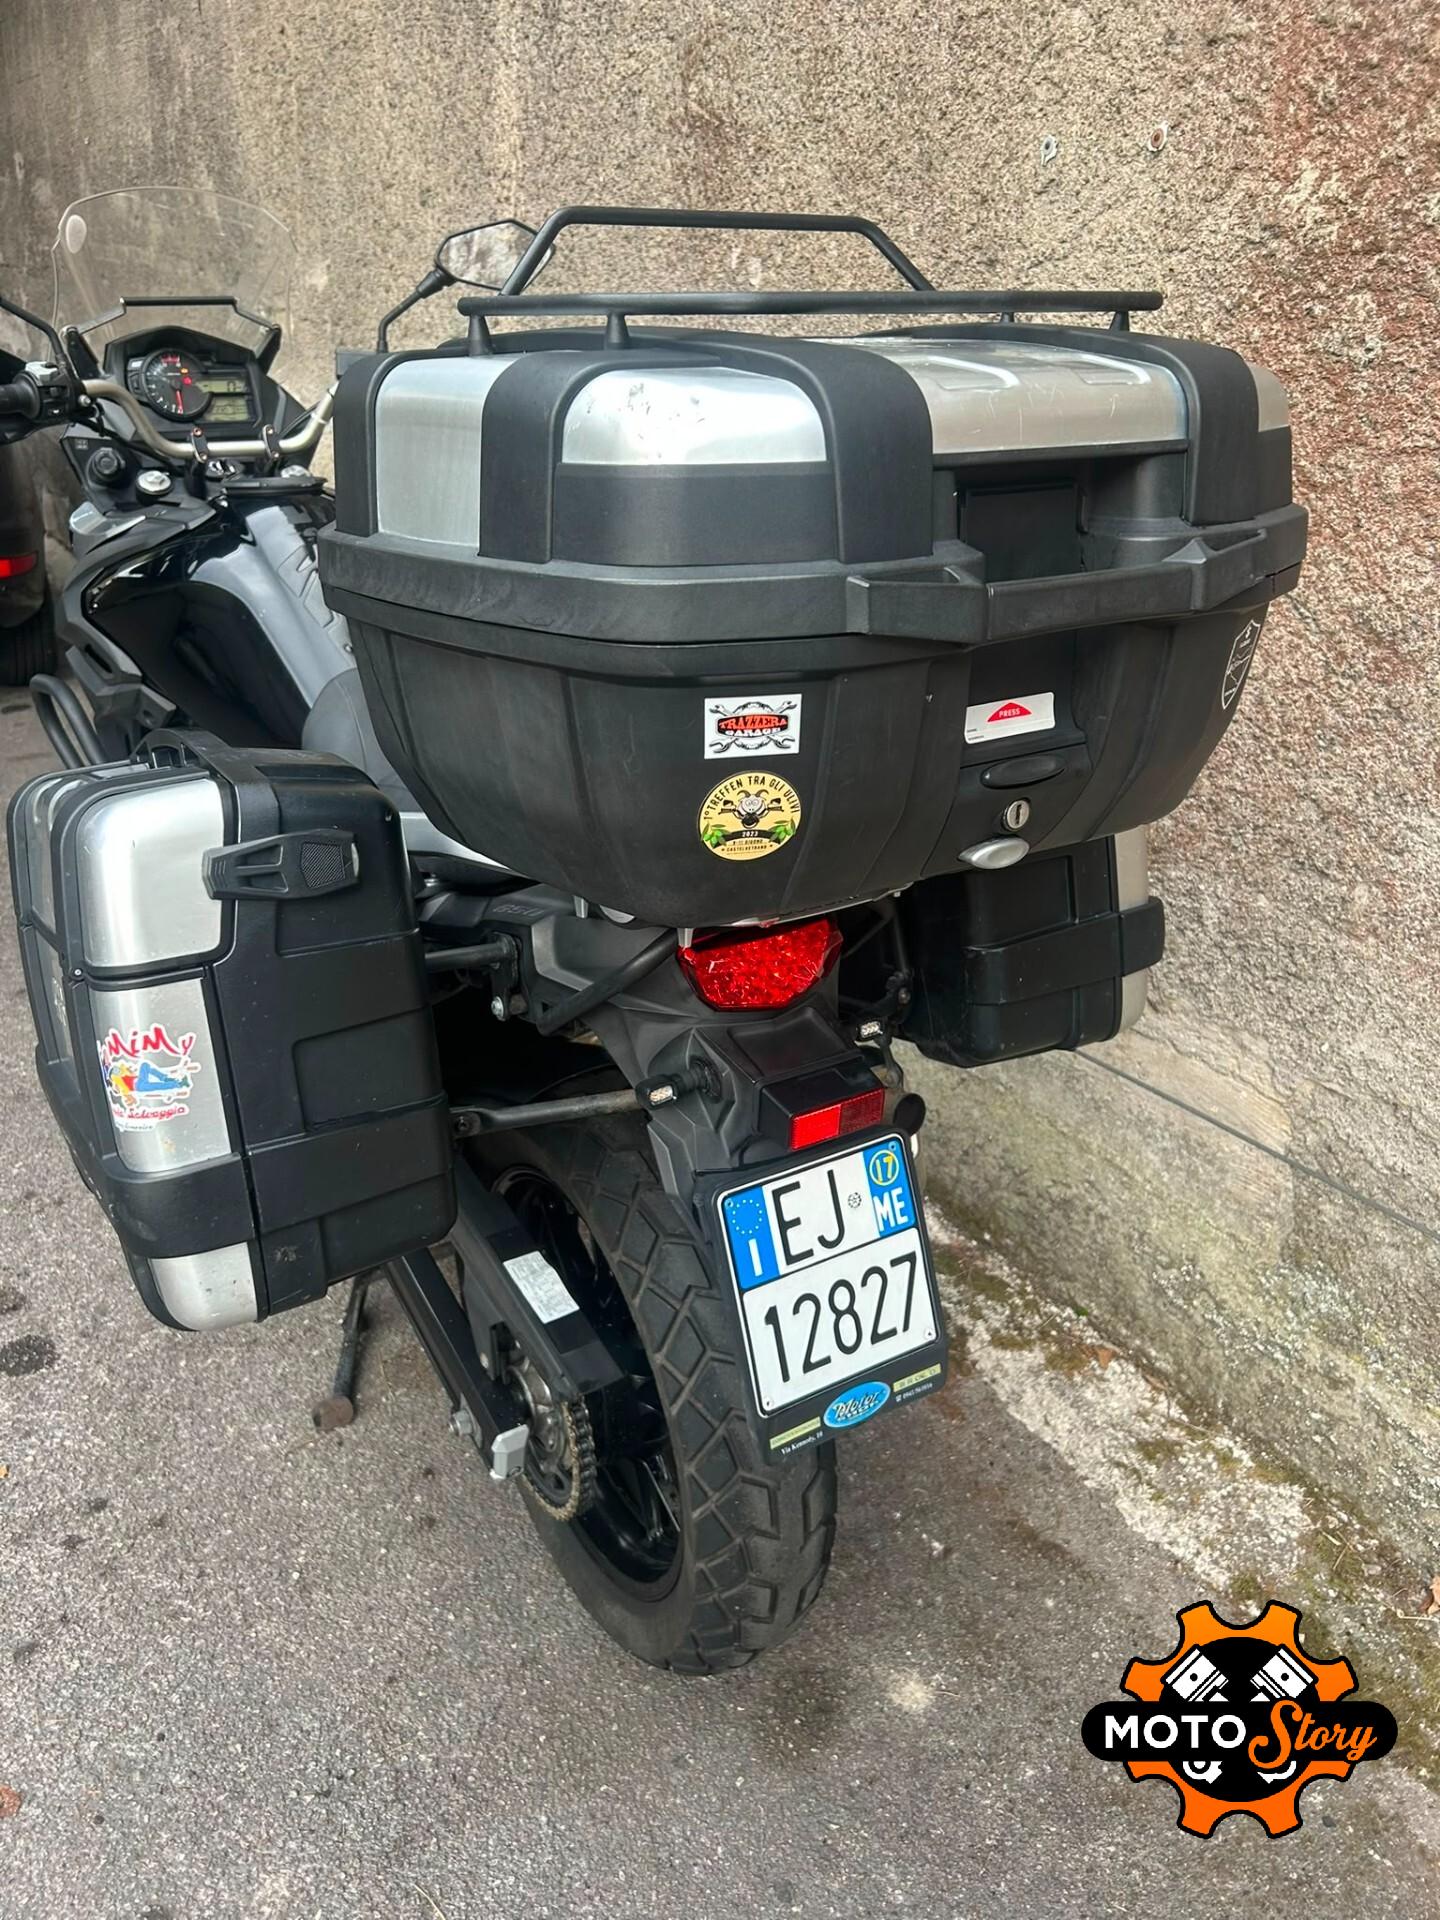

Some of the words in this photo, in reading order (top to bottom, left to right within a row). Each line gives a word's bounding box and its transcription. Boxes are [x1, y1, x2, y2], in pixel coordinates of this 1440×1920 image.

[719, 714, 788, 730] TRAZZERA
[999, 707, 1021, 718] PRESS
[724, 727, 781, 737] GARAGE
[707, 778, 743, 810] TREFFEN
[747, 775, 766, 786] TRA
[768, 778, 785, 792] GLI
[783, 789, 801, 814] ULIVI
[875, 1155, 894, 1183] 17
[771, 1169, 846, 1266] EJ
[872, 1187, 909, 1232] ME
[764, 1251, 917, 1383] 12827
